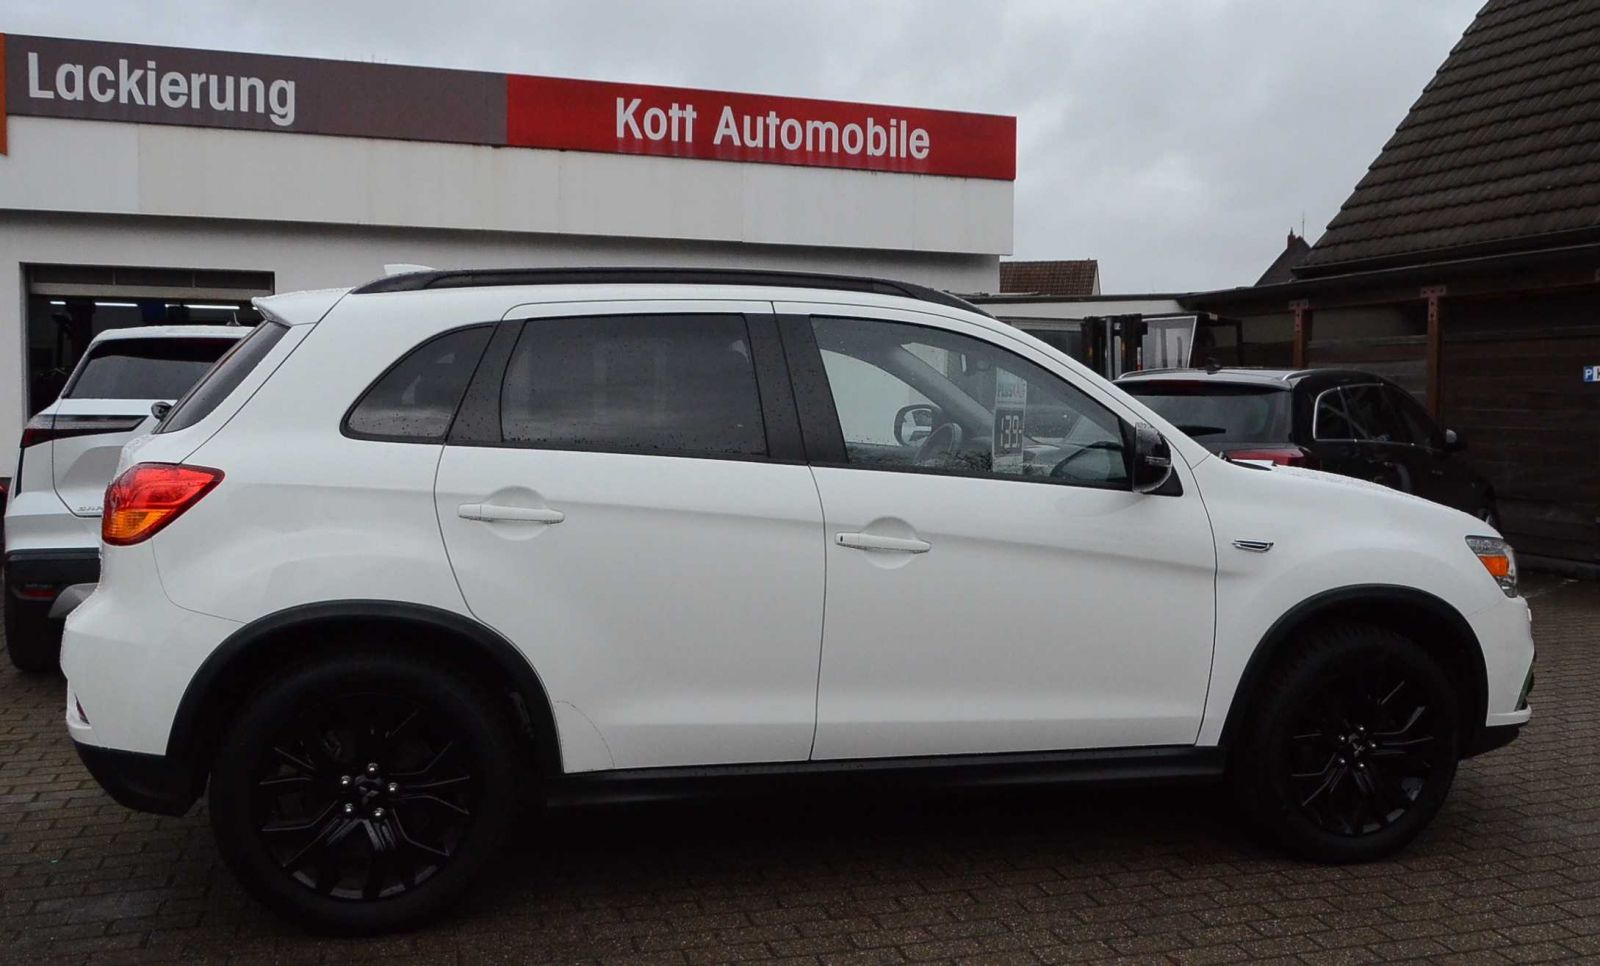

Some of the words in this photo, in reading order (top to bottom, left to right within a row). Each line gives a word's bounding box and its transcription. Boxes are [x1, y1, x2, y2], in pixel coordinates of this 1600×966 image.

[28, 52, 296, 127] Lackierung
[616, 97, 697, 143] Kott
[713, 105, 930, 160] Automobile
